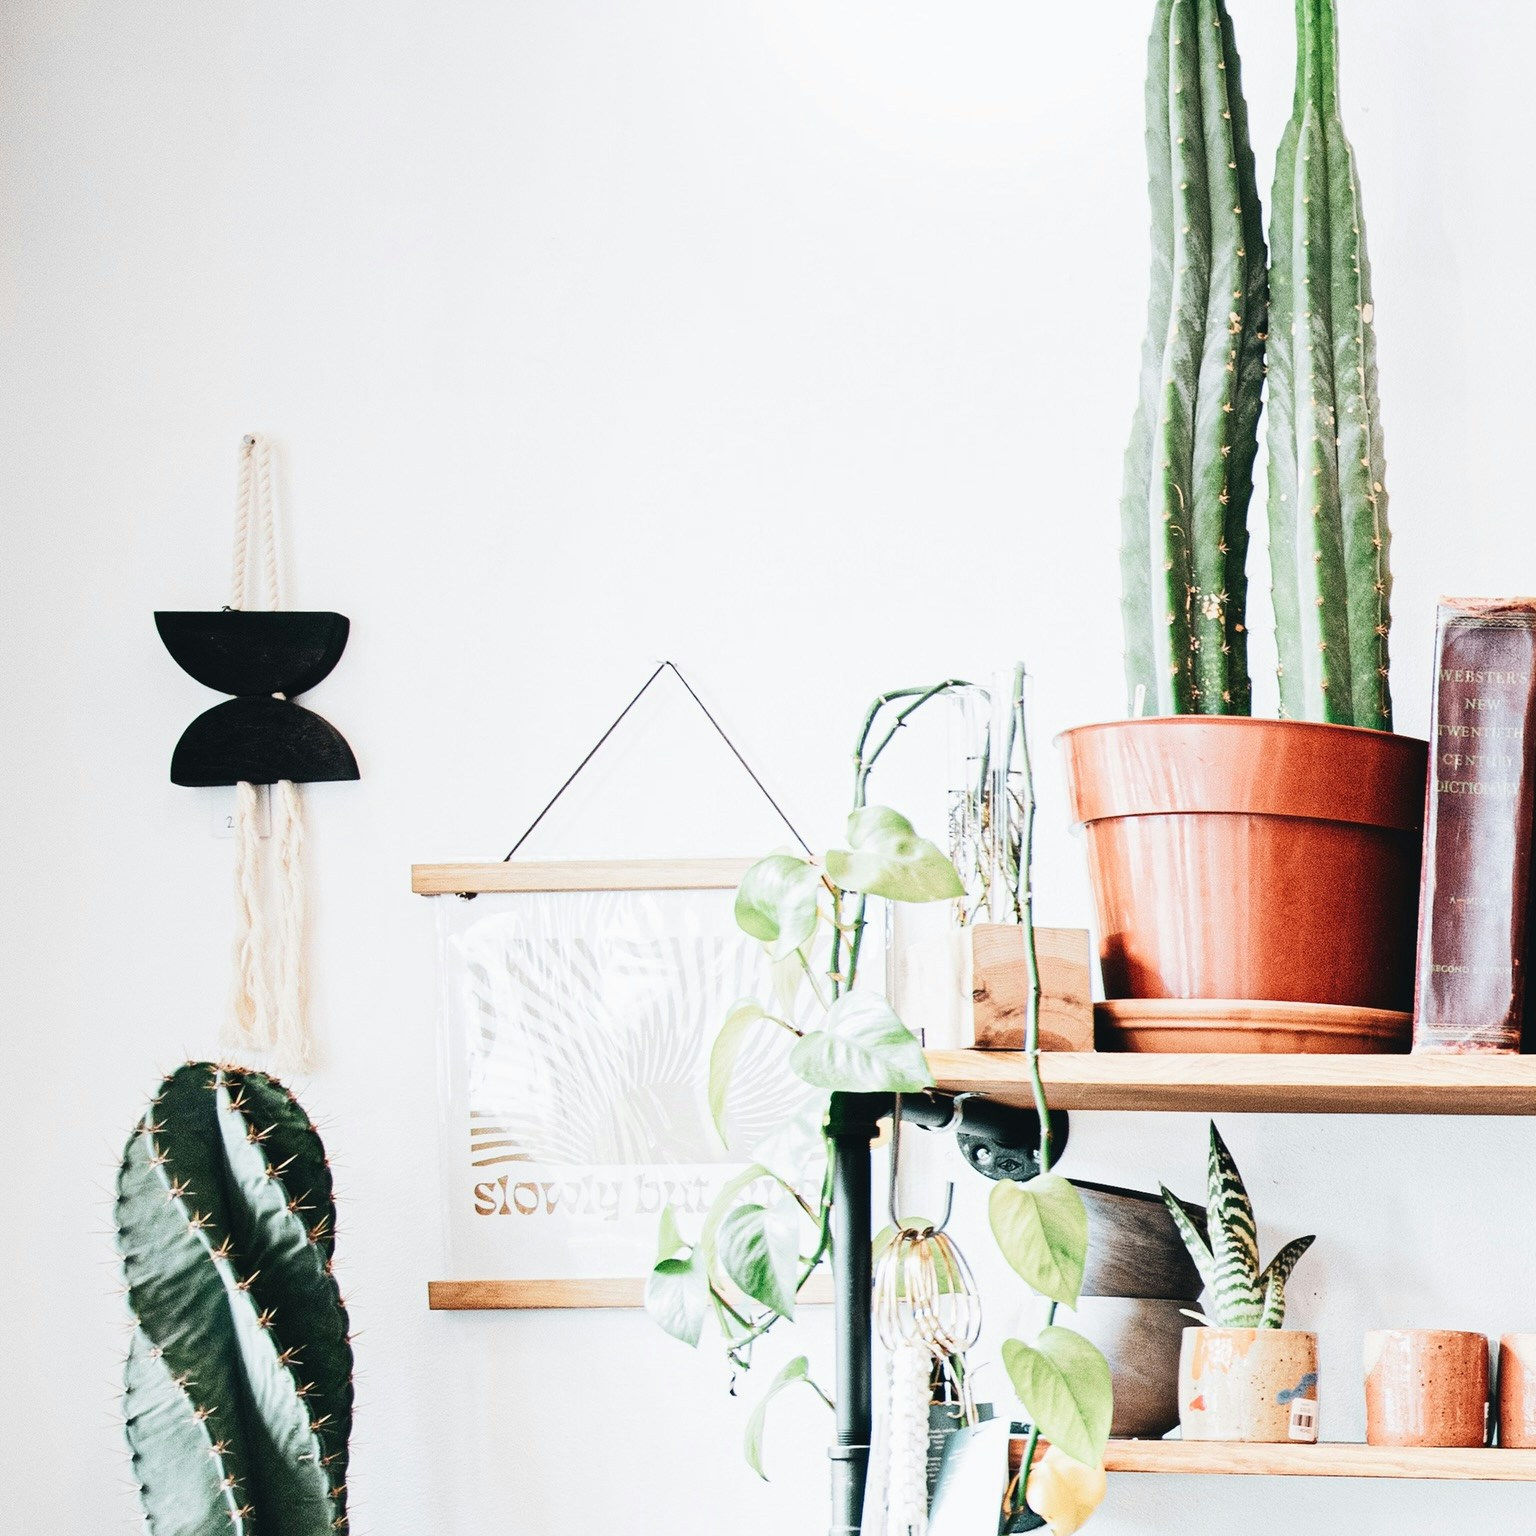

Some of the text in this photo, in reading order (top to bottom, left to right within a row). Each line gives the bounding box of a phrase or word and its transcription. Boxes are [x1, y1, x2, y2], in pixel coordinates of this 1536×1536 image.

[1465, 698, 1501, 710] NEW
[1437, 725, 1524, 739] TWENTIETH
[1443, 753, 1513, 767] CENTURY
[1436, 781, 1519, 796] DICTIONARY
